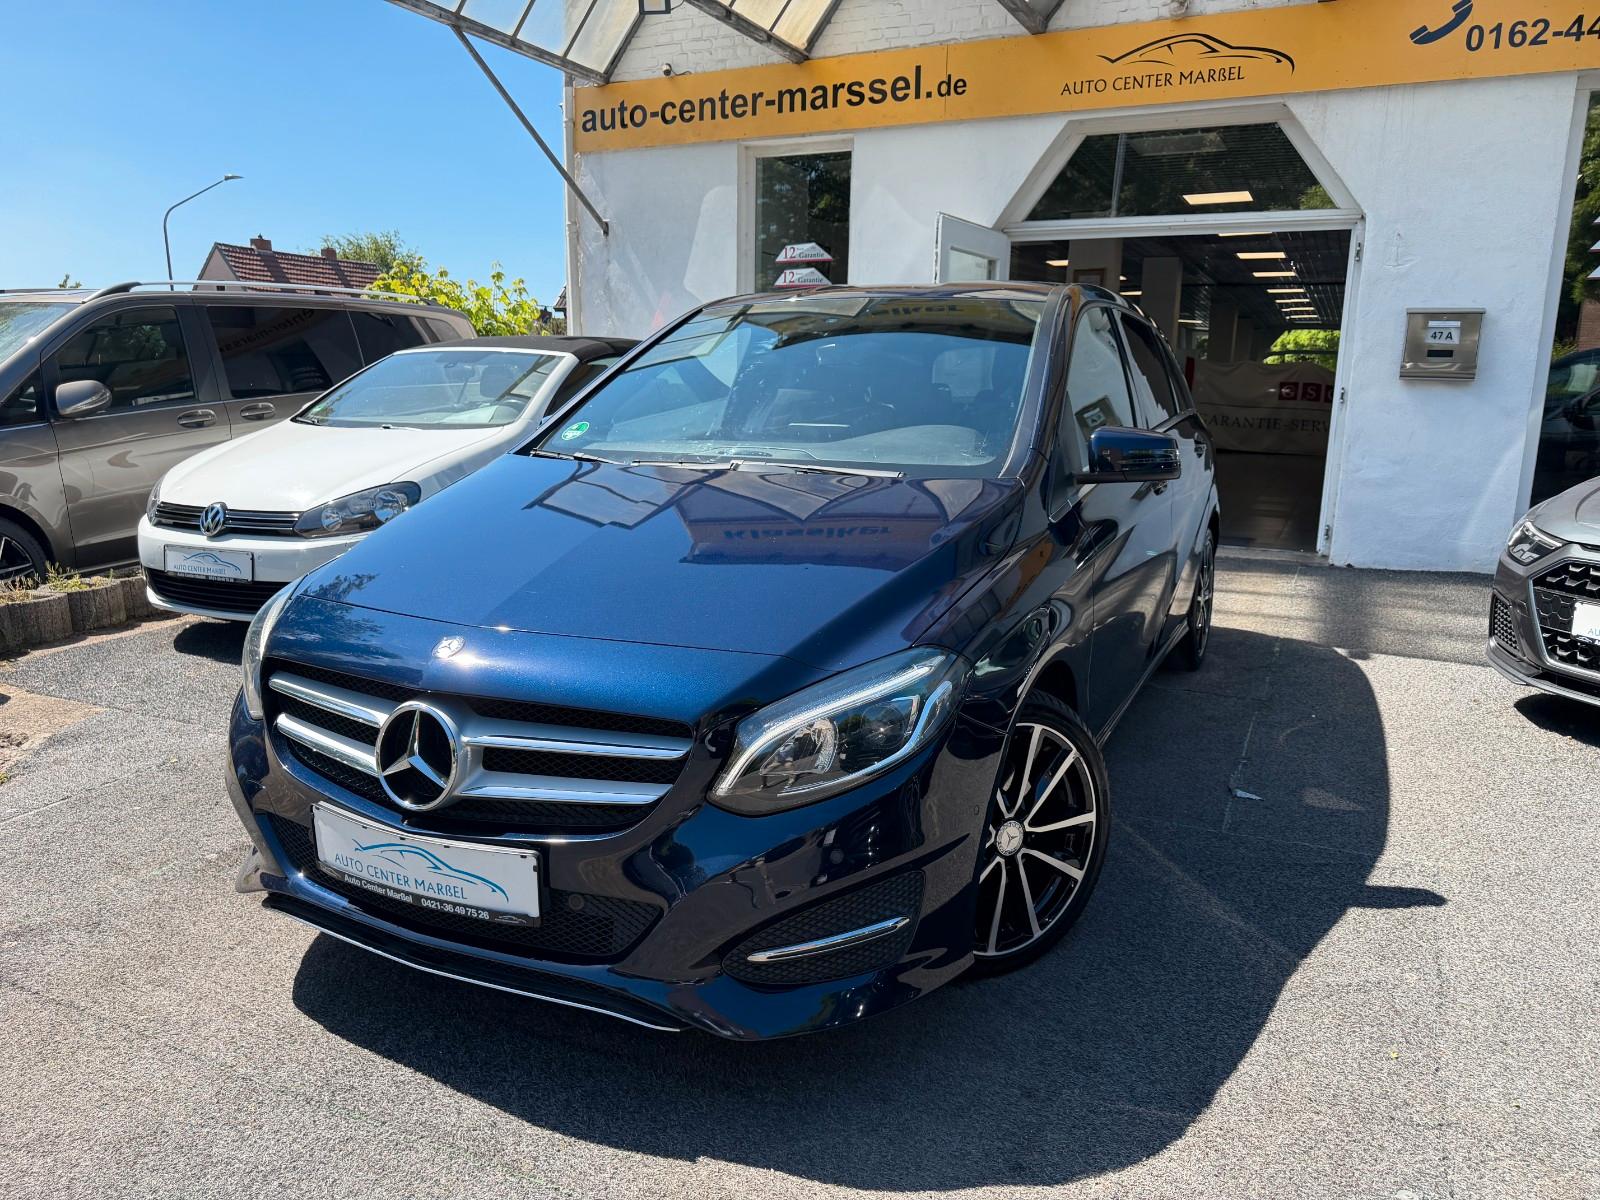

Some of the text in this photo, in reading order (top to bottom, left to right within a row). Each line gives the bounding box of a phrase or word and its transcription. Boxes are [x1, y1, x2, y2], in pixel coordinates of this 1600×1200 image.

[1060, 79, 1107, 96] AUTO
[1112, 73, 1173, 91] CENTER
[783, 247, 796, 259] 12
[783, 271, 795, 283] 12
[1430, 331, 1453, 340] 47 A
[335, 852, 364, 873] AUTO
[366, 864, 411, 888] CENTER
[344, 873, 361, 887] Auto
[361, 879, 386, 895] Center
[421, 898, 454, 914] 0421-36
[454, 904, 466, 915] 49
[467, 906, 478, 918] 75
